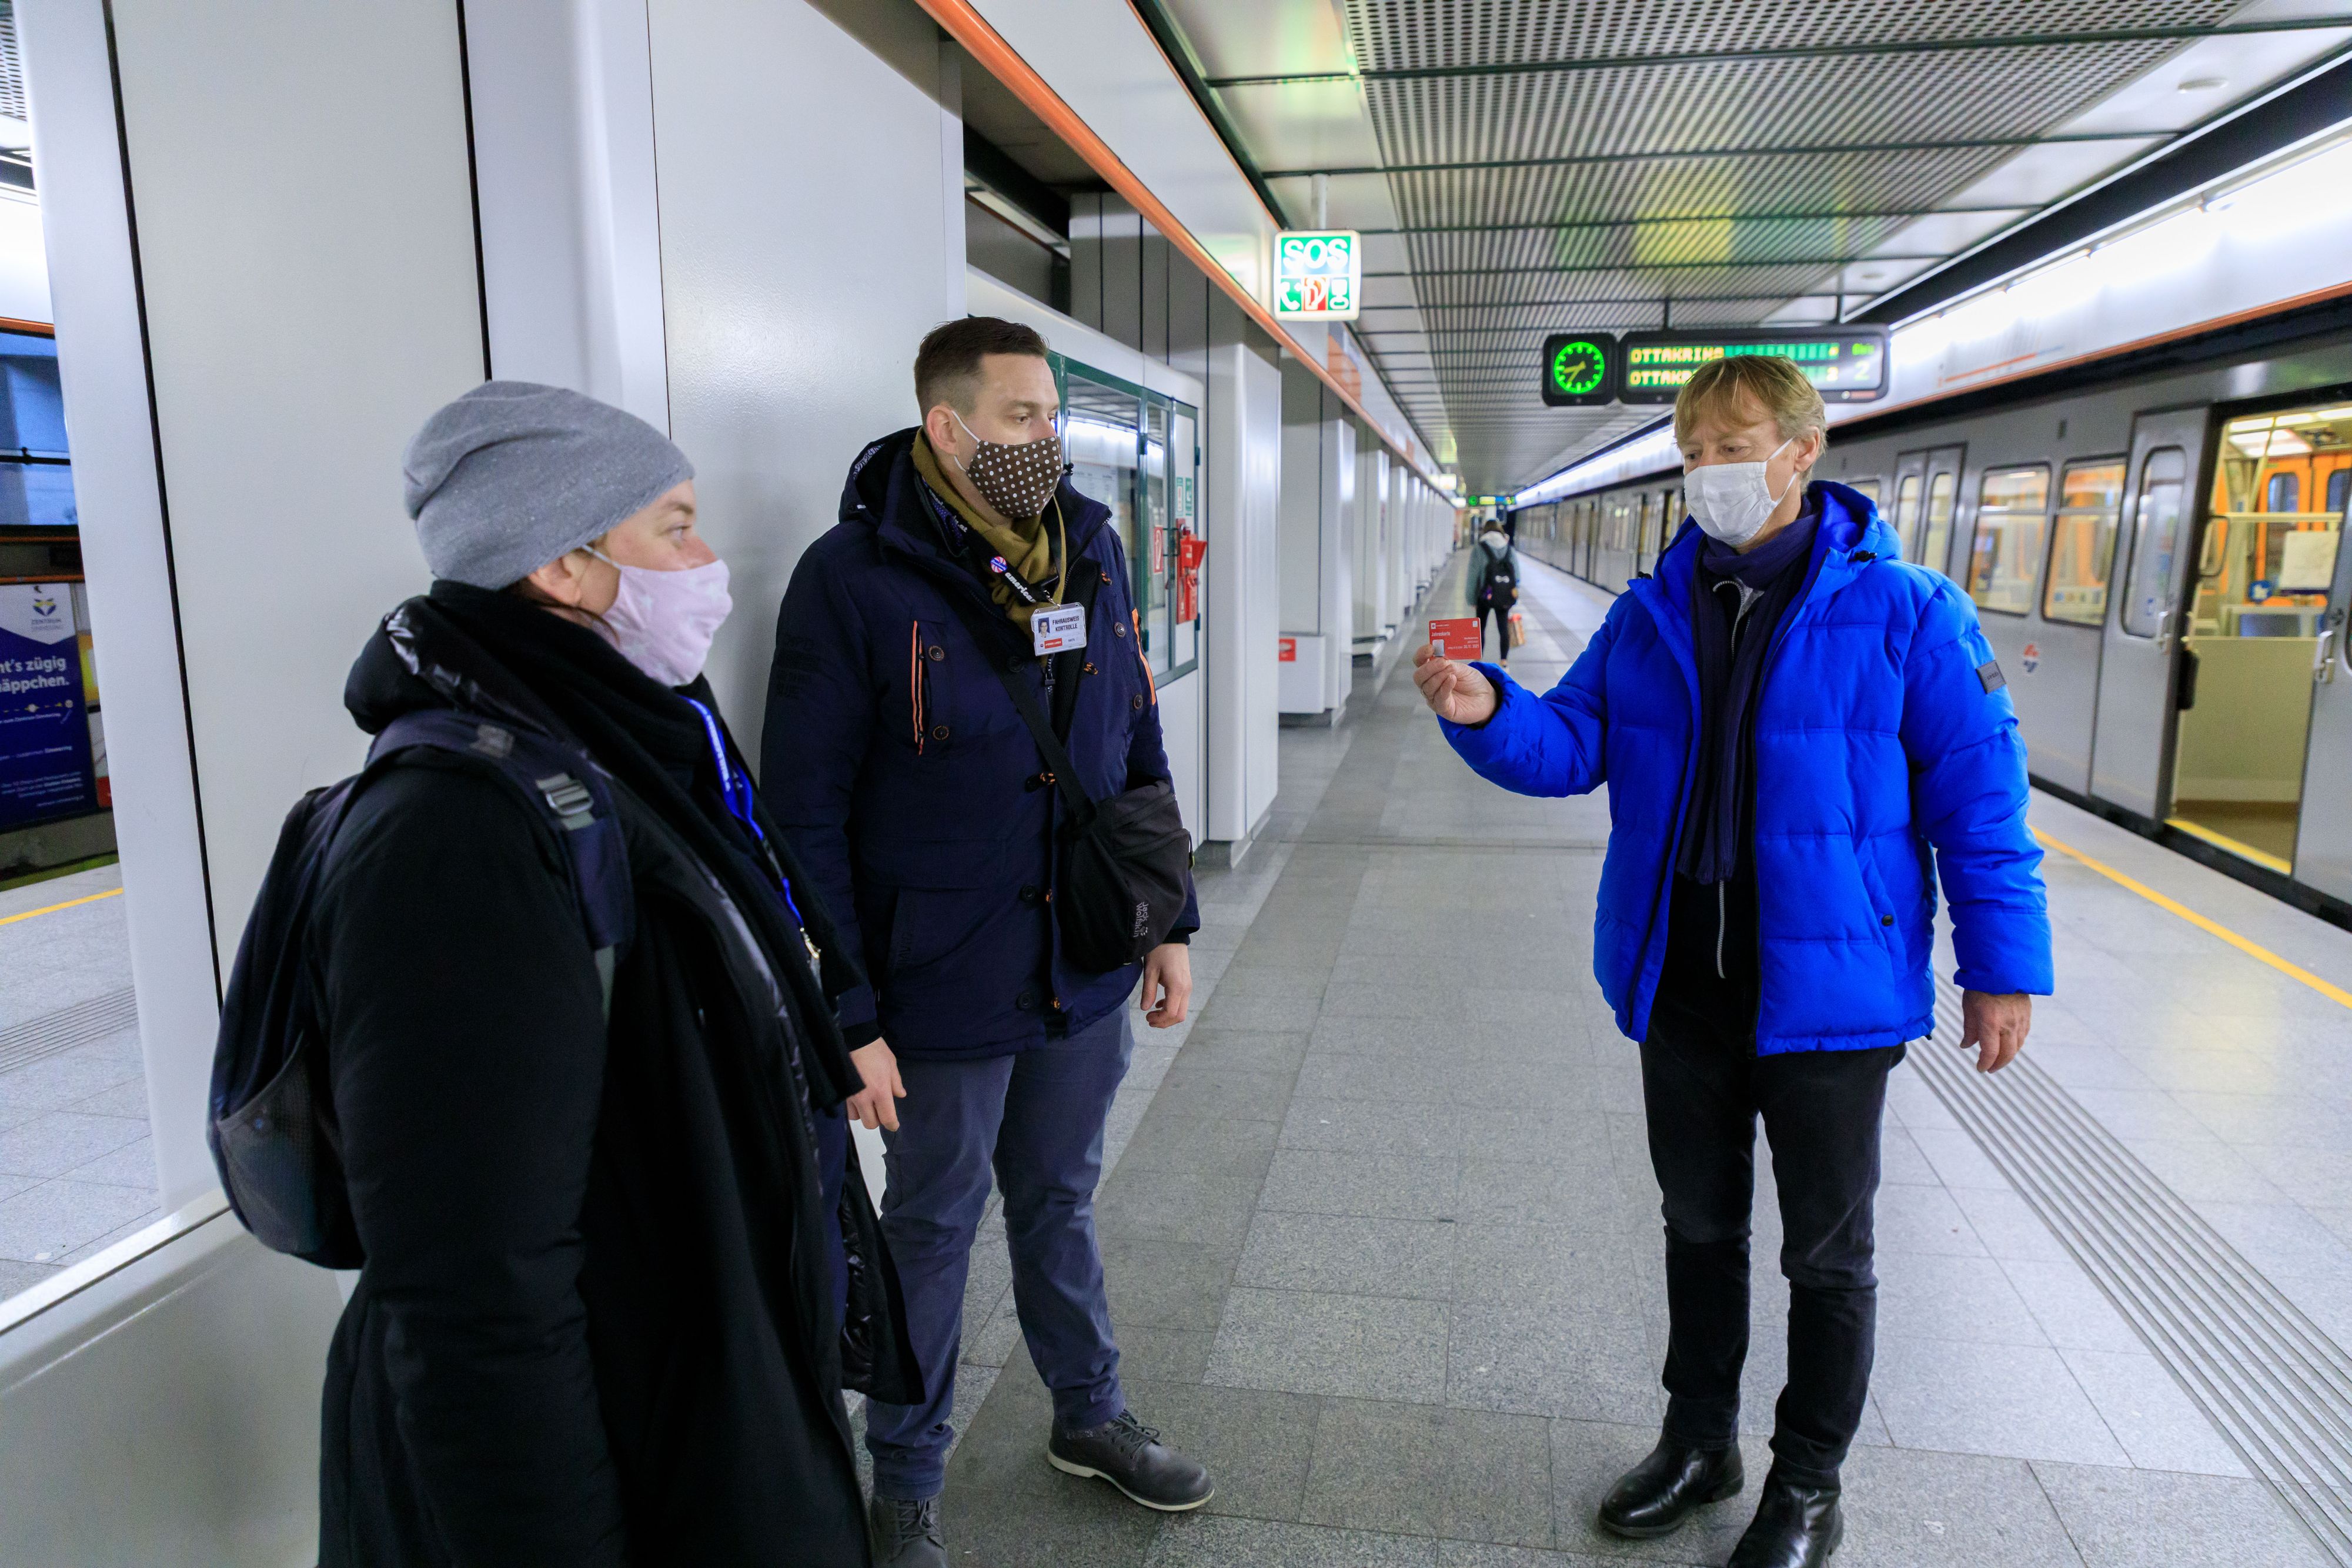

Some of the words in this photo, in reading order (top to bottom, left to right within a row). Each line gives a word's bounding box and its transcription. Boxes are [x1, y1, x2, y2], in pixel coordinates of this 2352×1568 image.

[1283, 239, 1348, 269] SOS
[1853, 360, 1870, 381] 2
[1053, 616, 1080, 625] FAHRAUSWEIS
[1055, 623, 1078, 631] KONTROLLE
[25, 655, 66, 673] zügig
[0, 675, 70, 694] äppchen.
[1133, 902, 1143, 937] Wolfskin
